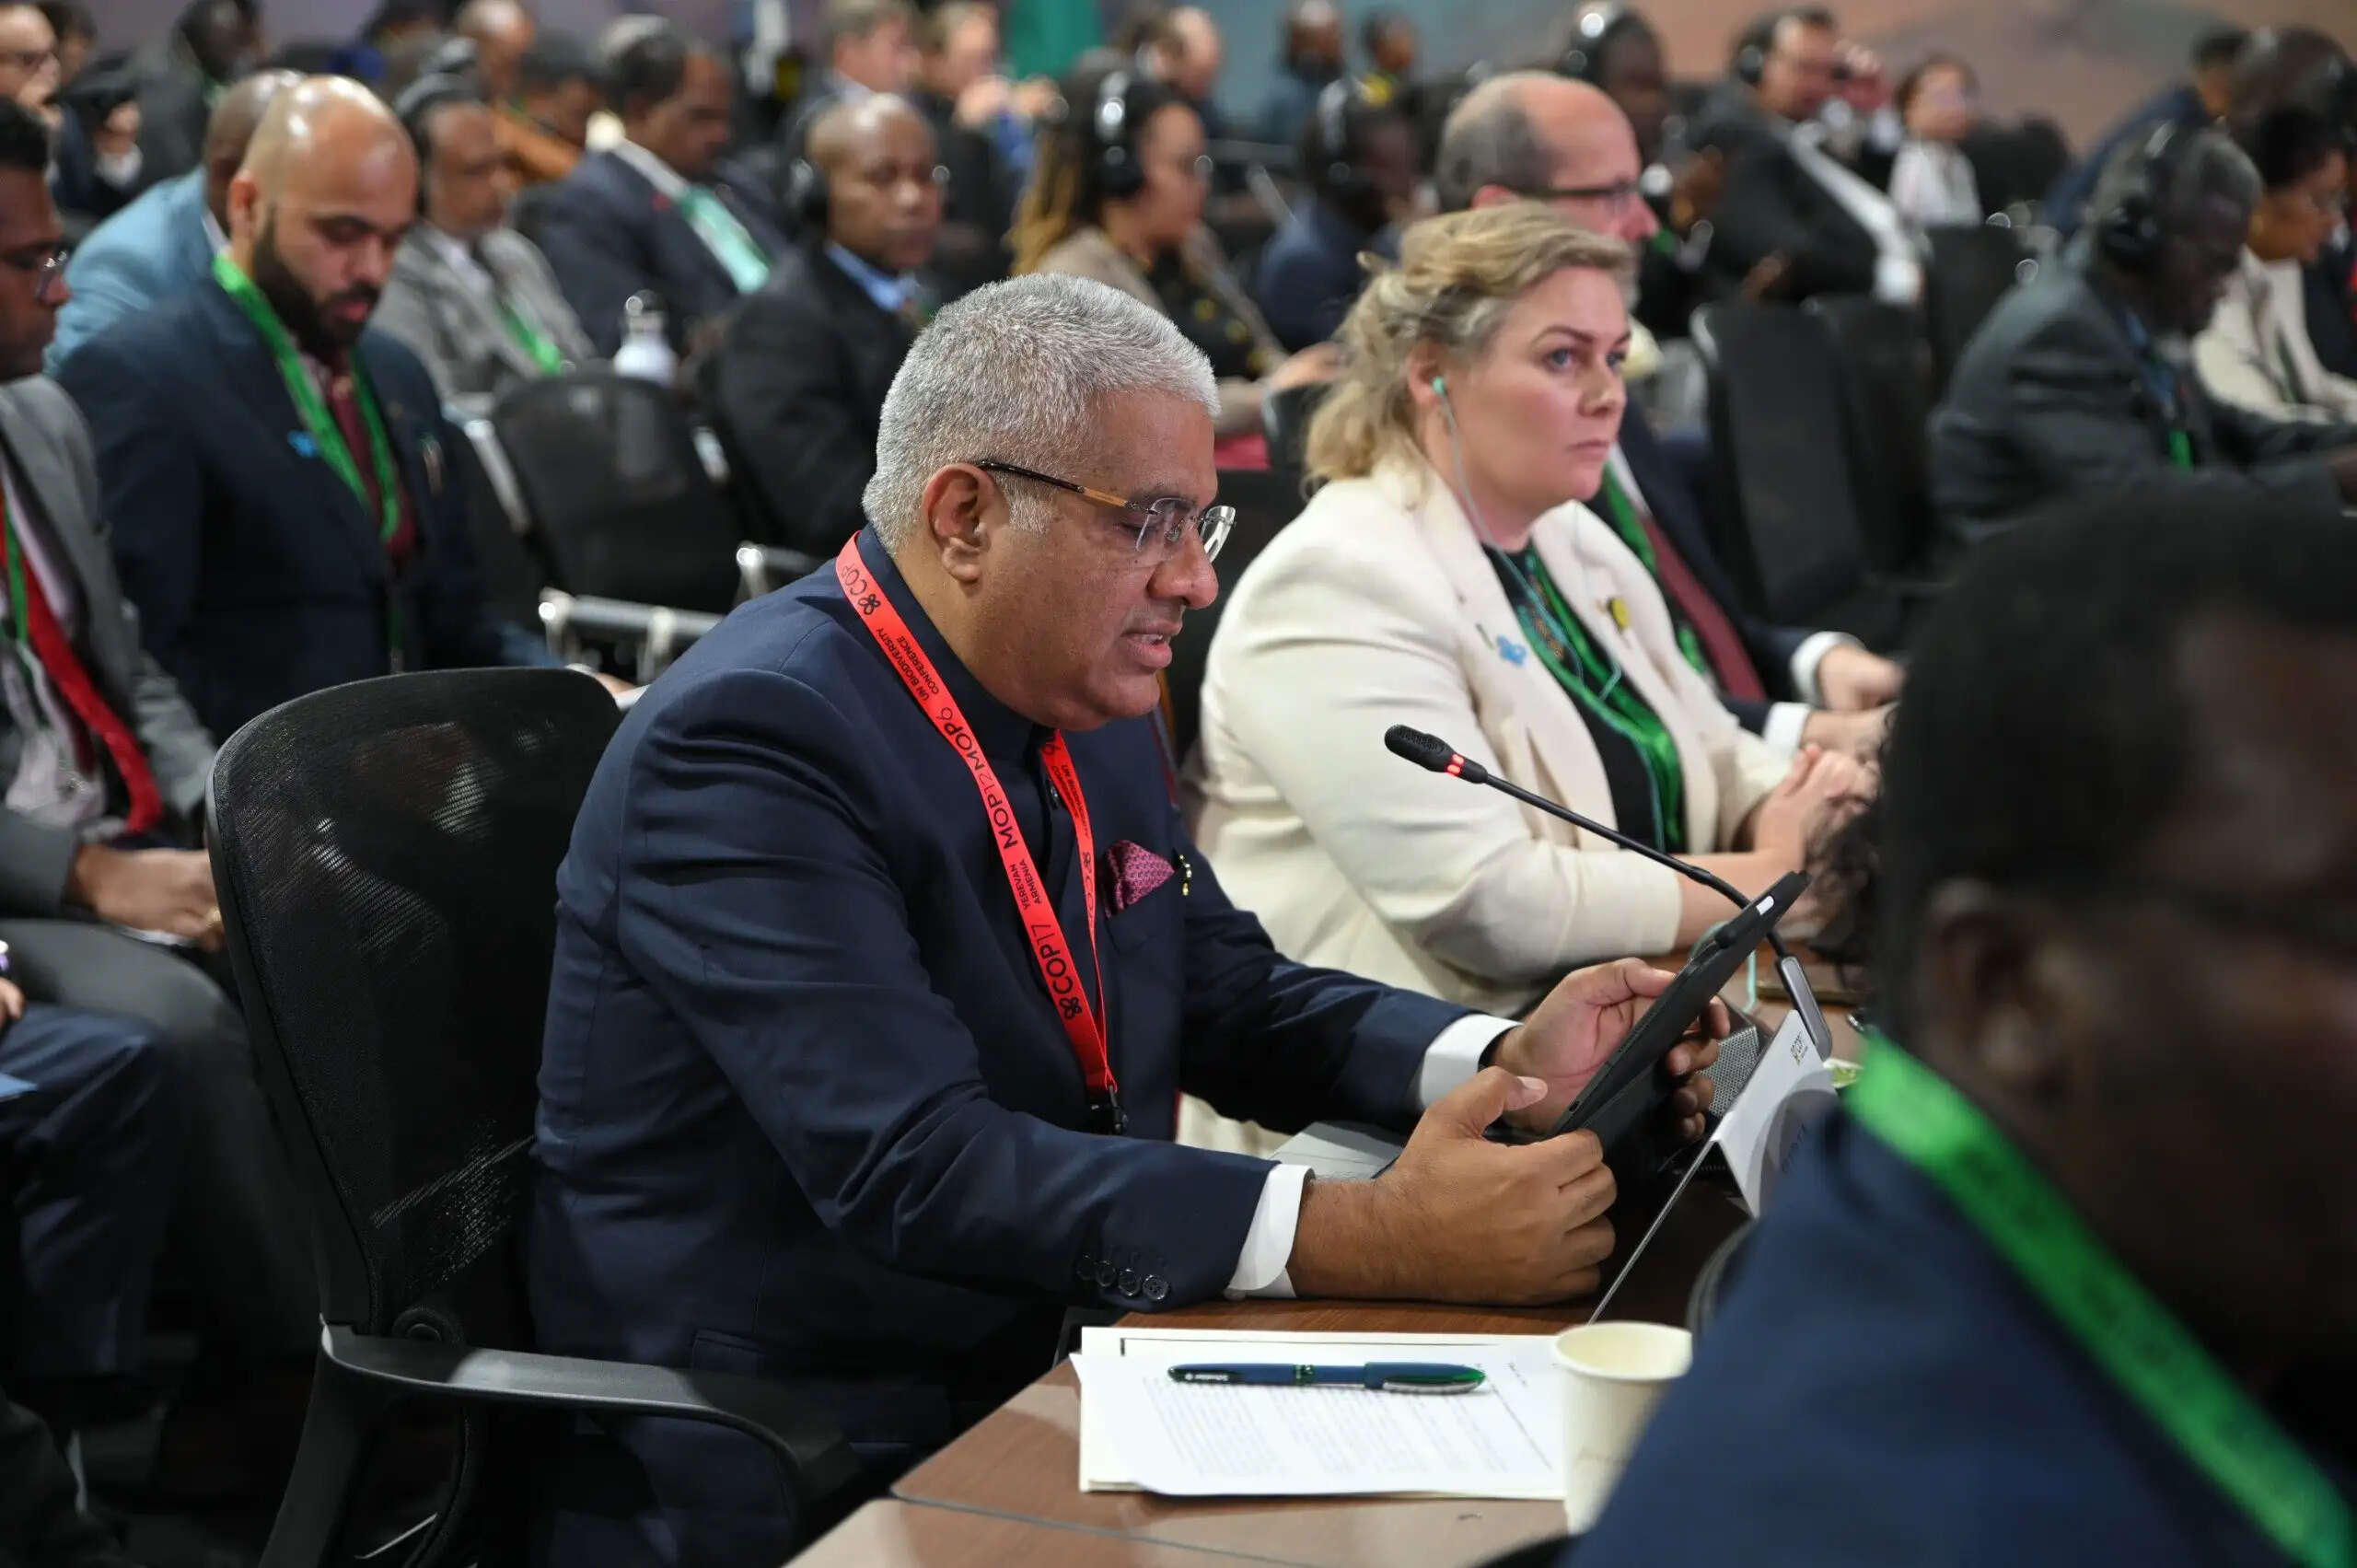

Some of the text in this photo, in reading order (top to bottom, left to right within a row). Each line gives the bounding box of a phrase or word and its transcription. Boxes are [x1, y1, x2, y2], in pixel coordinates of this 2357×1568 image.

[877, 628, 930, 701] UN BIODIVERSITY
[897, 635, 939, 694] CONFERENCE
[1010, 864, 1031, 910] YEREVAN
[1019, 859, 1041, 904] ARMENIA
[1031, 924, 1074, 994] COP17
